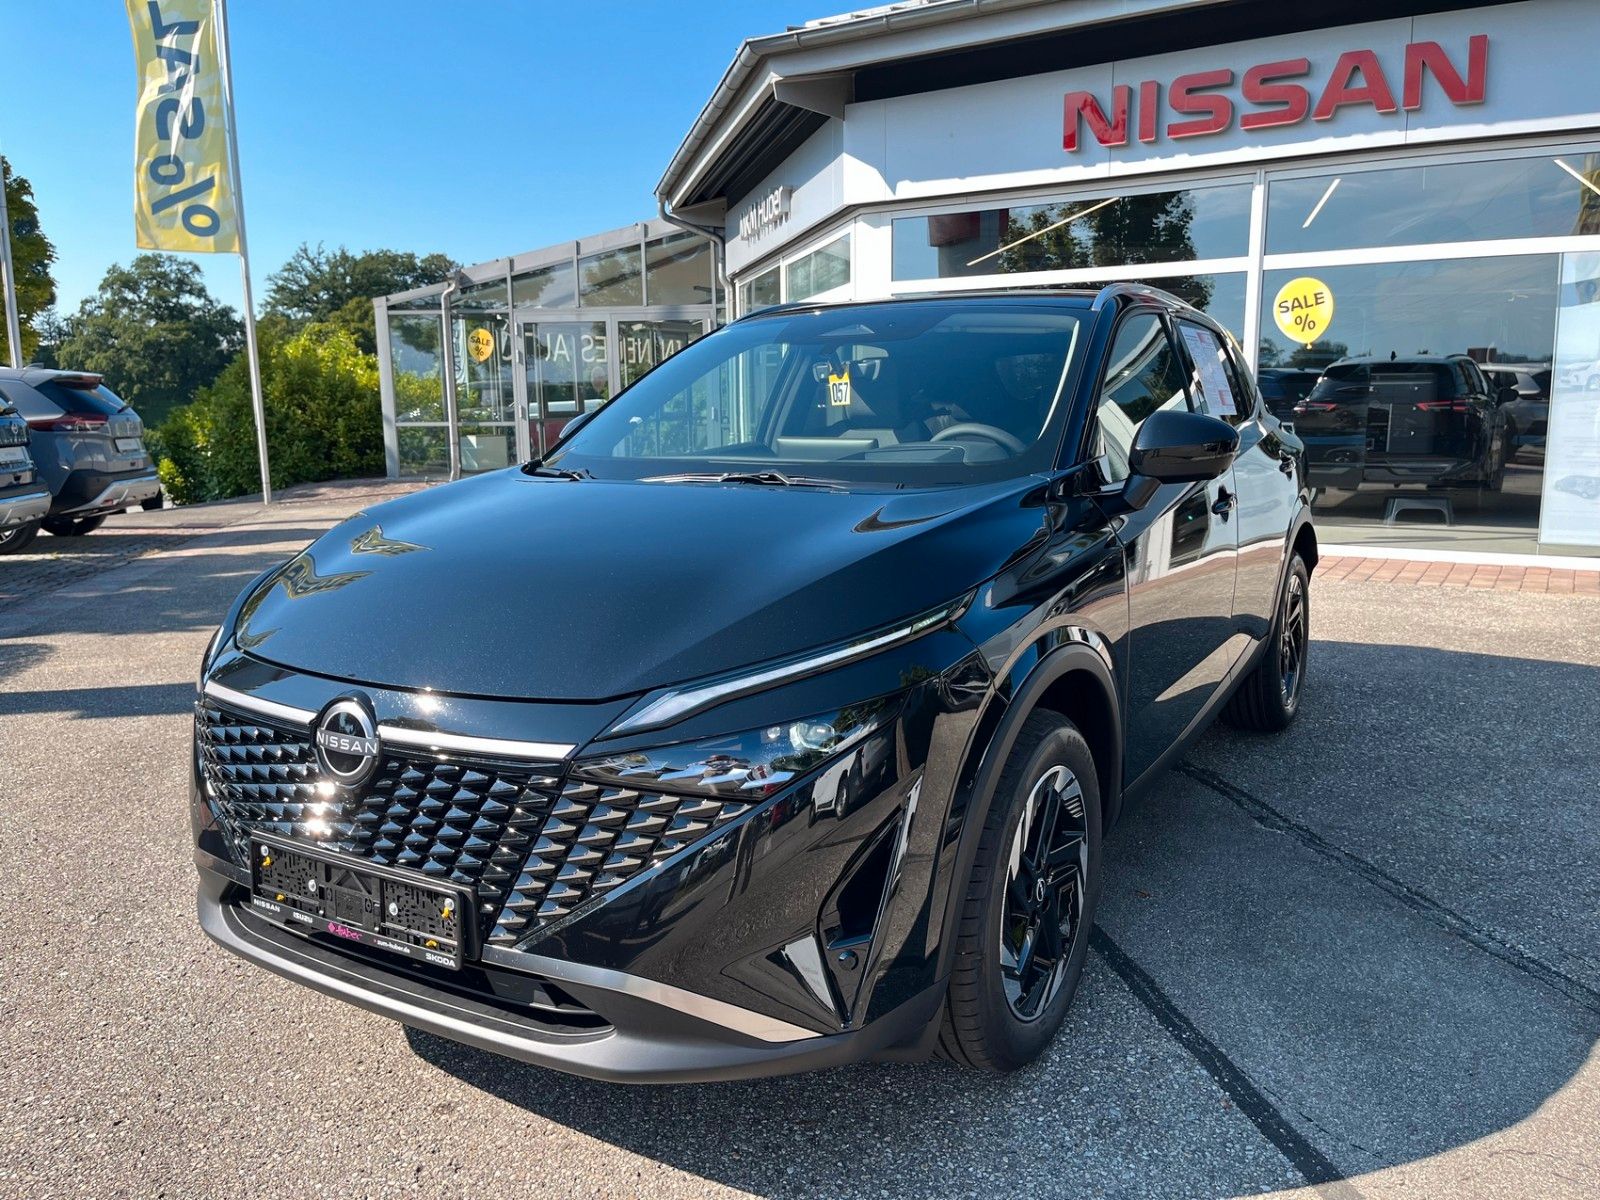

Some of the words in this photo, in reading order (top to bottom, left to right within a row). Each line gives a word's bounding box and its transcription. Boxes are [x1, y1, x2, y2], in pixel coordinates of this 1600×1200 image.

[1063, 34, 1488, 152] NISSAN
[1278, 291, 1325, 314] SALE
[1294, 313, 1316, 333] %
[470, 335, 491, 347] SALE
[832, 382, 848, 403] 057
[316, 731, 377, 754] NISSAN
[253, 898, 280, 912] NISSAN
[293, 911, 313, 923] ISUZU
